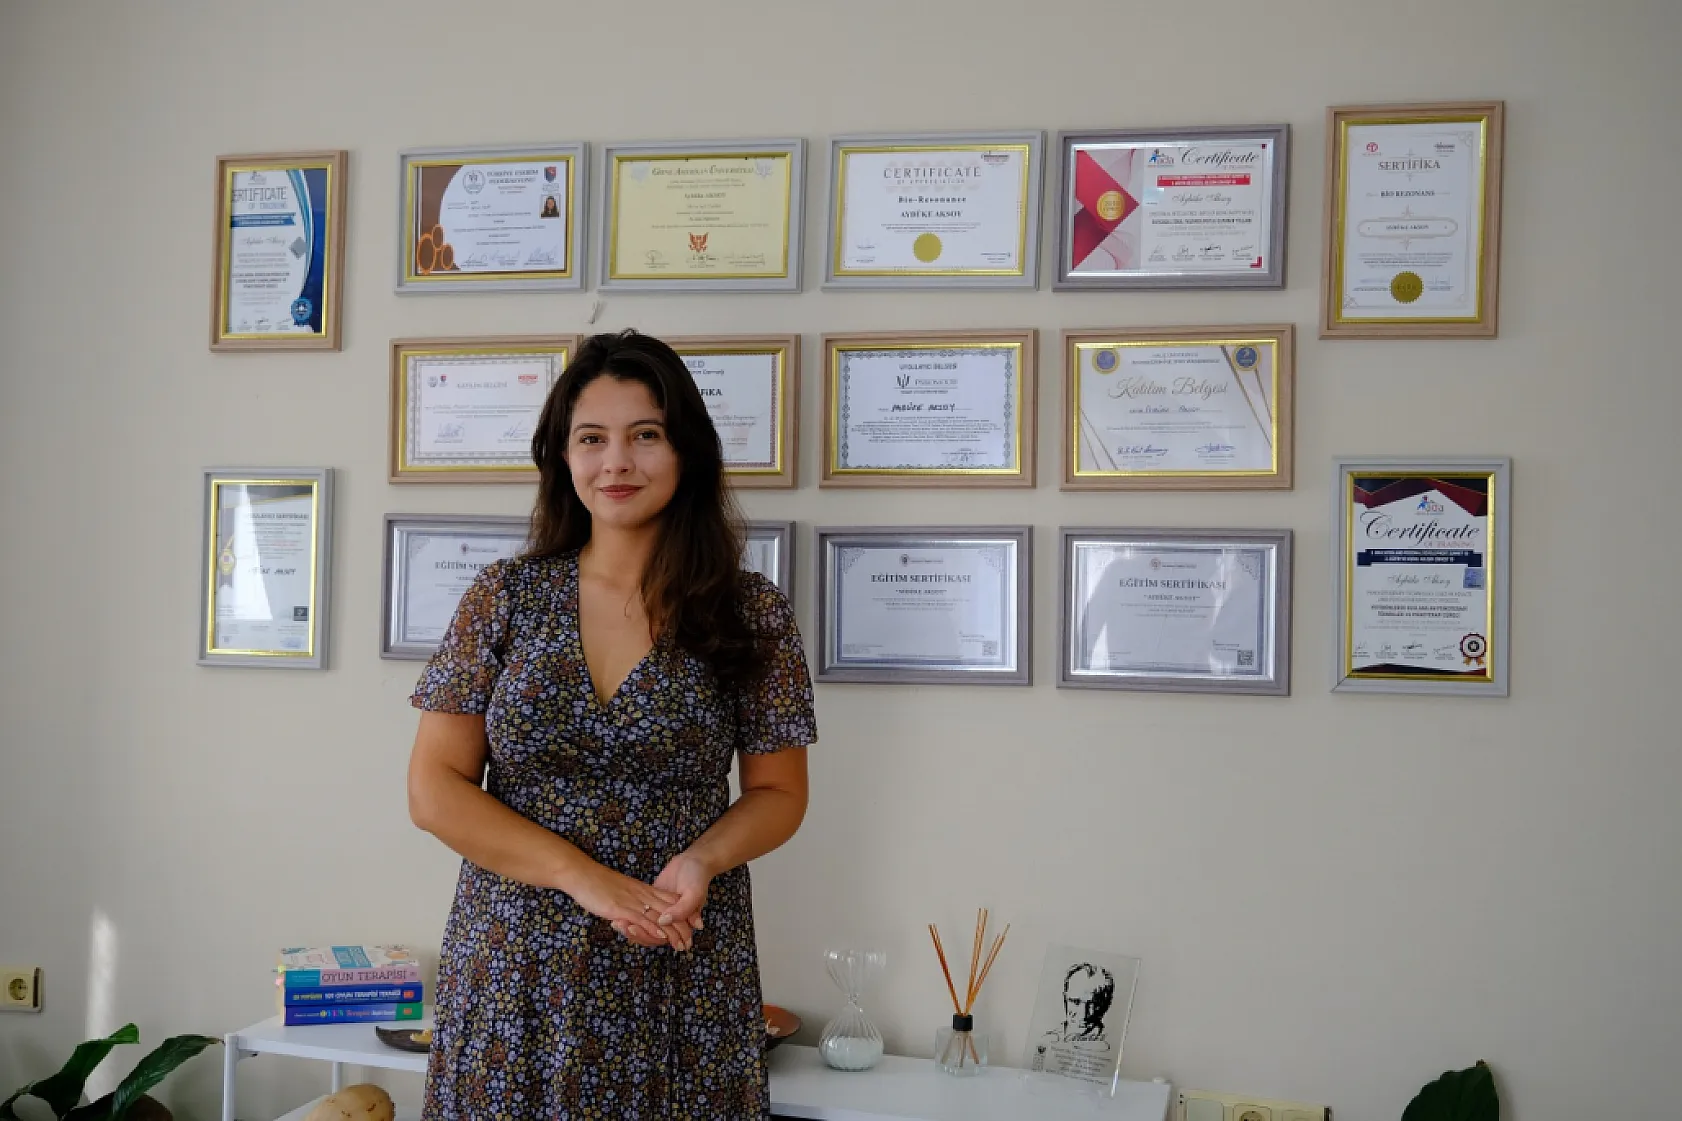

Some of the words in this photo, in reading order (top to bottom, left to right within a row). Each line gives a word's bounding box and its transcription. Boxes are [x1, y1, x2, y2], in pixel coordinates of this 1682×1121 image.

[1178, 147, 1260, 170] Certificate
[1378, 157, 1441, 170] SERTİFİKA
[883, 166, 982, 179] CERTIFICATE
[232, 186, 288, 203] ERTIFICATE
[1360, 511, 1480, 548] Certificate
[435, 560, 467, 570] EĞİTİM
[871, 572, 908, 583] EĞİTİM
[909, 571, 972, 583] SERTİFİKASI
[1119, 577, 1158, 588] EĞİTİM
[1160, 578, 1227, 590] SERTİFİKASI
[321, 972, 354, 983] OYUN
[357, 969, 408, 981] TERAPİSİ
